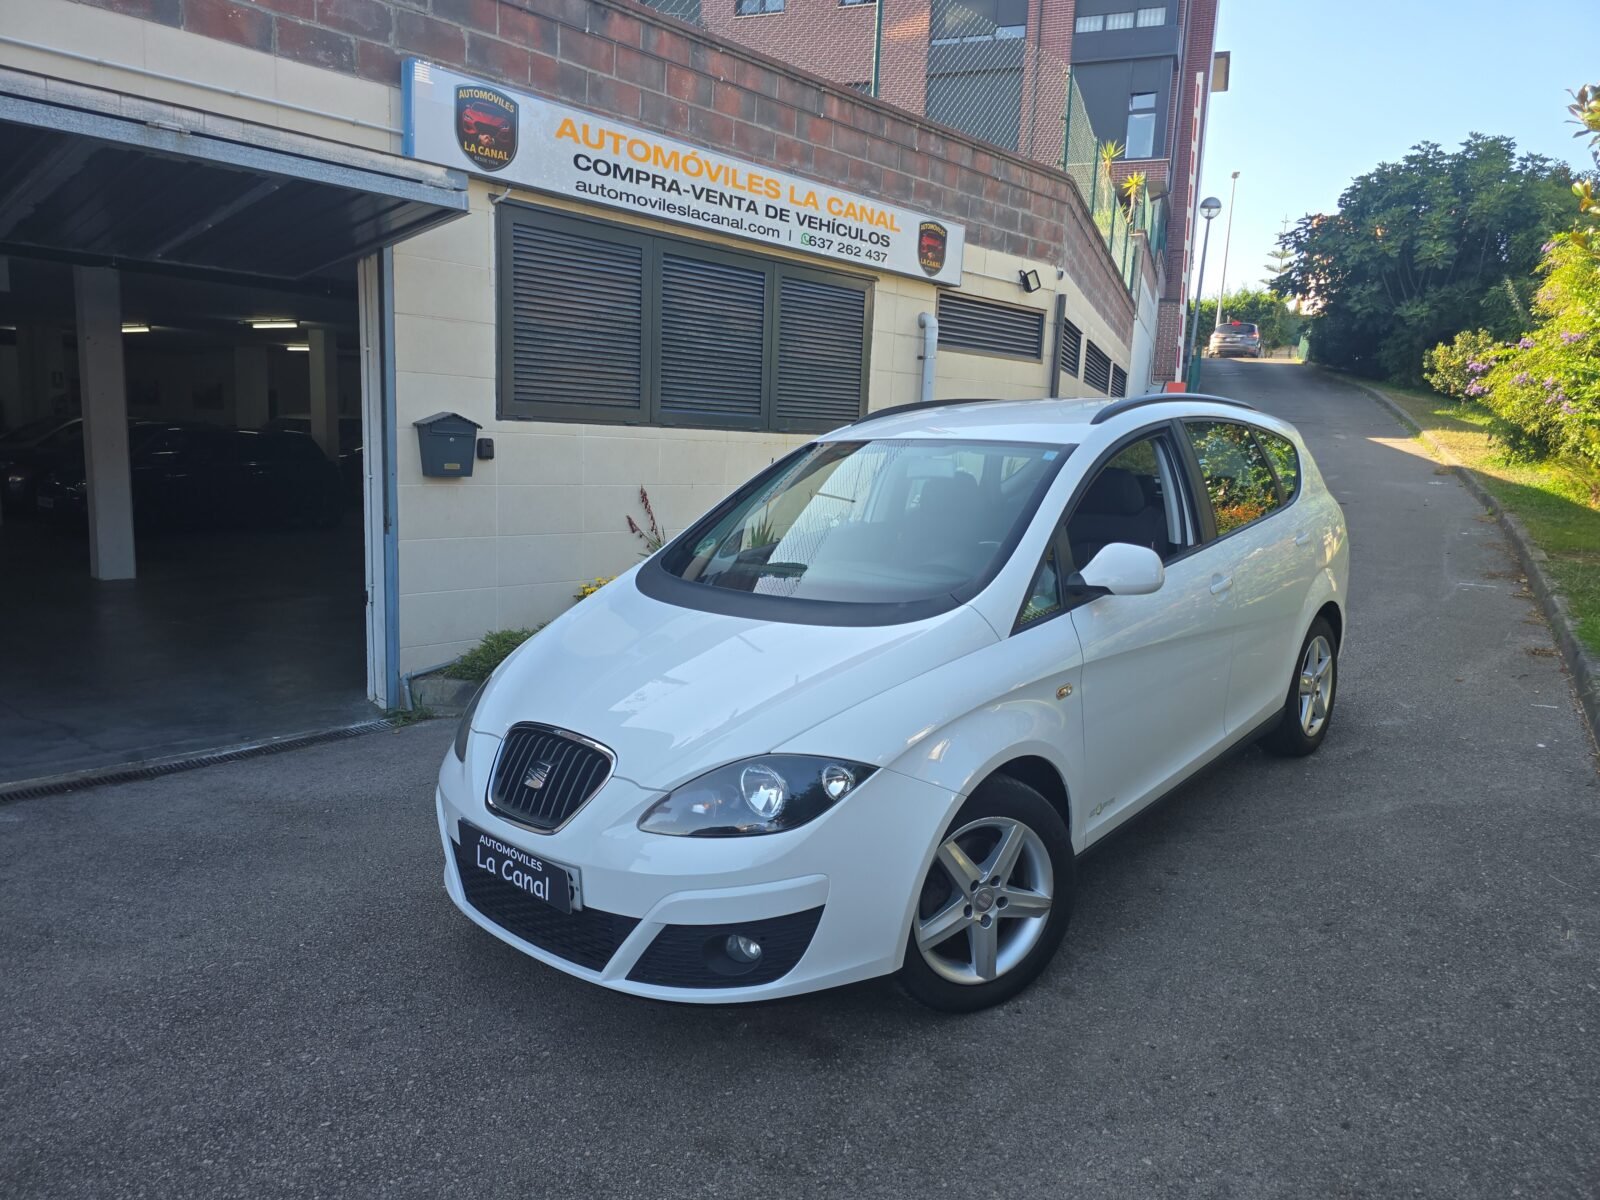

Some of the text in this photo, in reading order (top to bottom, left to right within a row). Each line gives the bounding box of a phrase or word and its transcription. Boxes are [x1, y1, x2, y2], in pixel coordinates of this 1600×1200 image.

[464, 141, 509, 160] LA CANAL
[555, 117, 901, 233] AUTOMÓVILES LA CANAL
[573, 153, 891, 248] COMPRA-VENTA DE VEHÍCULOS
[575, 180, 780, 238] automovileslacanal.com
[808, 235, 888, 263] 637 262 437
[477, 845, 549, 901] La Canal
[479, 835, 543, 871] AUTOMÓVILES
